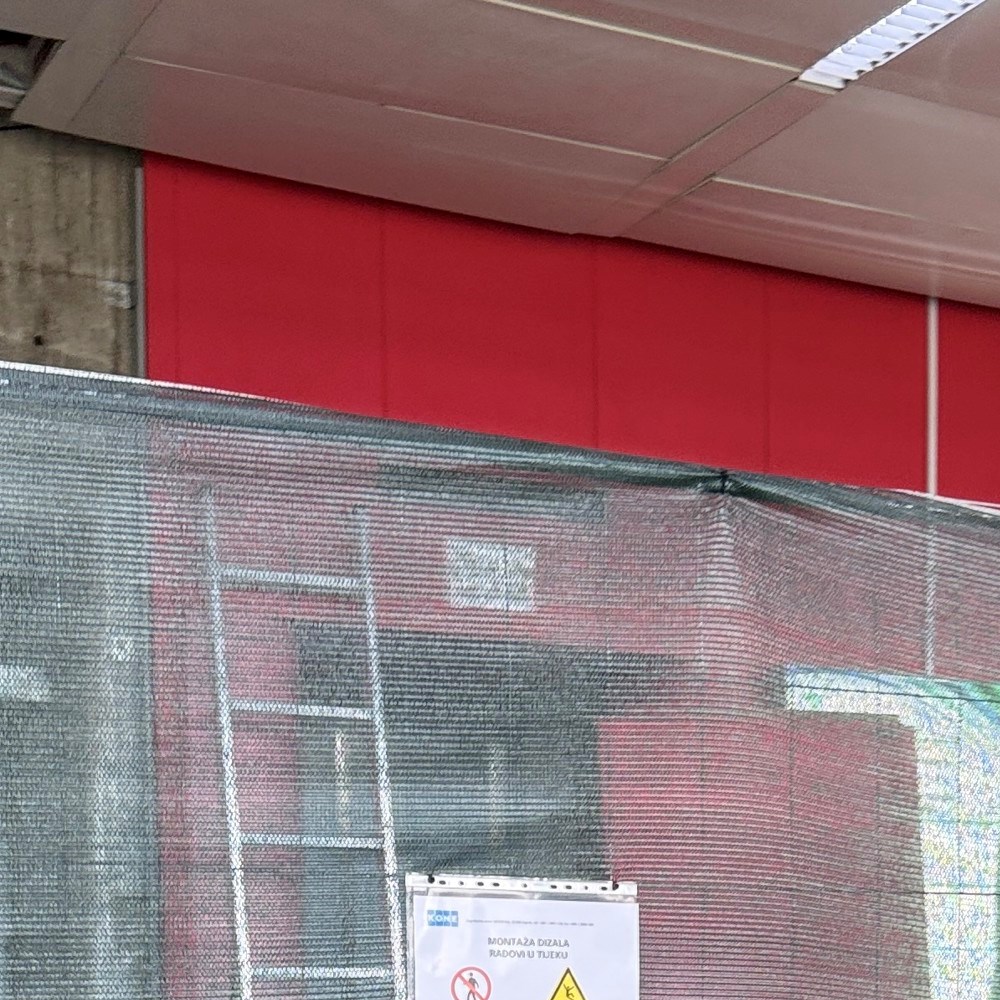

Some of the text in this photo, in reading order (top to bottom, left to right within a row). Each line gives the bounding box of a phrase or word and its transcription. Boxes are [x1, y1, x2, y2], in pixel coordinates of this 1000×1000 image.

[428, 914, 458, 923] KONE
[488, 936, 570, 948] MONTAŽA DIZALA
[489, 949, 569, 960] RADOVI U TIJEKU
